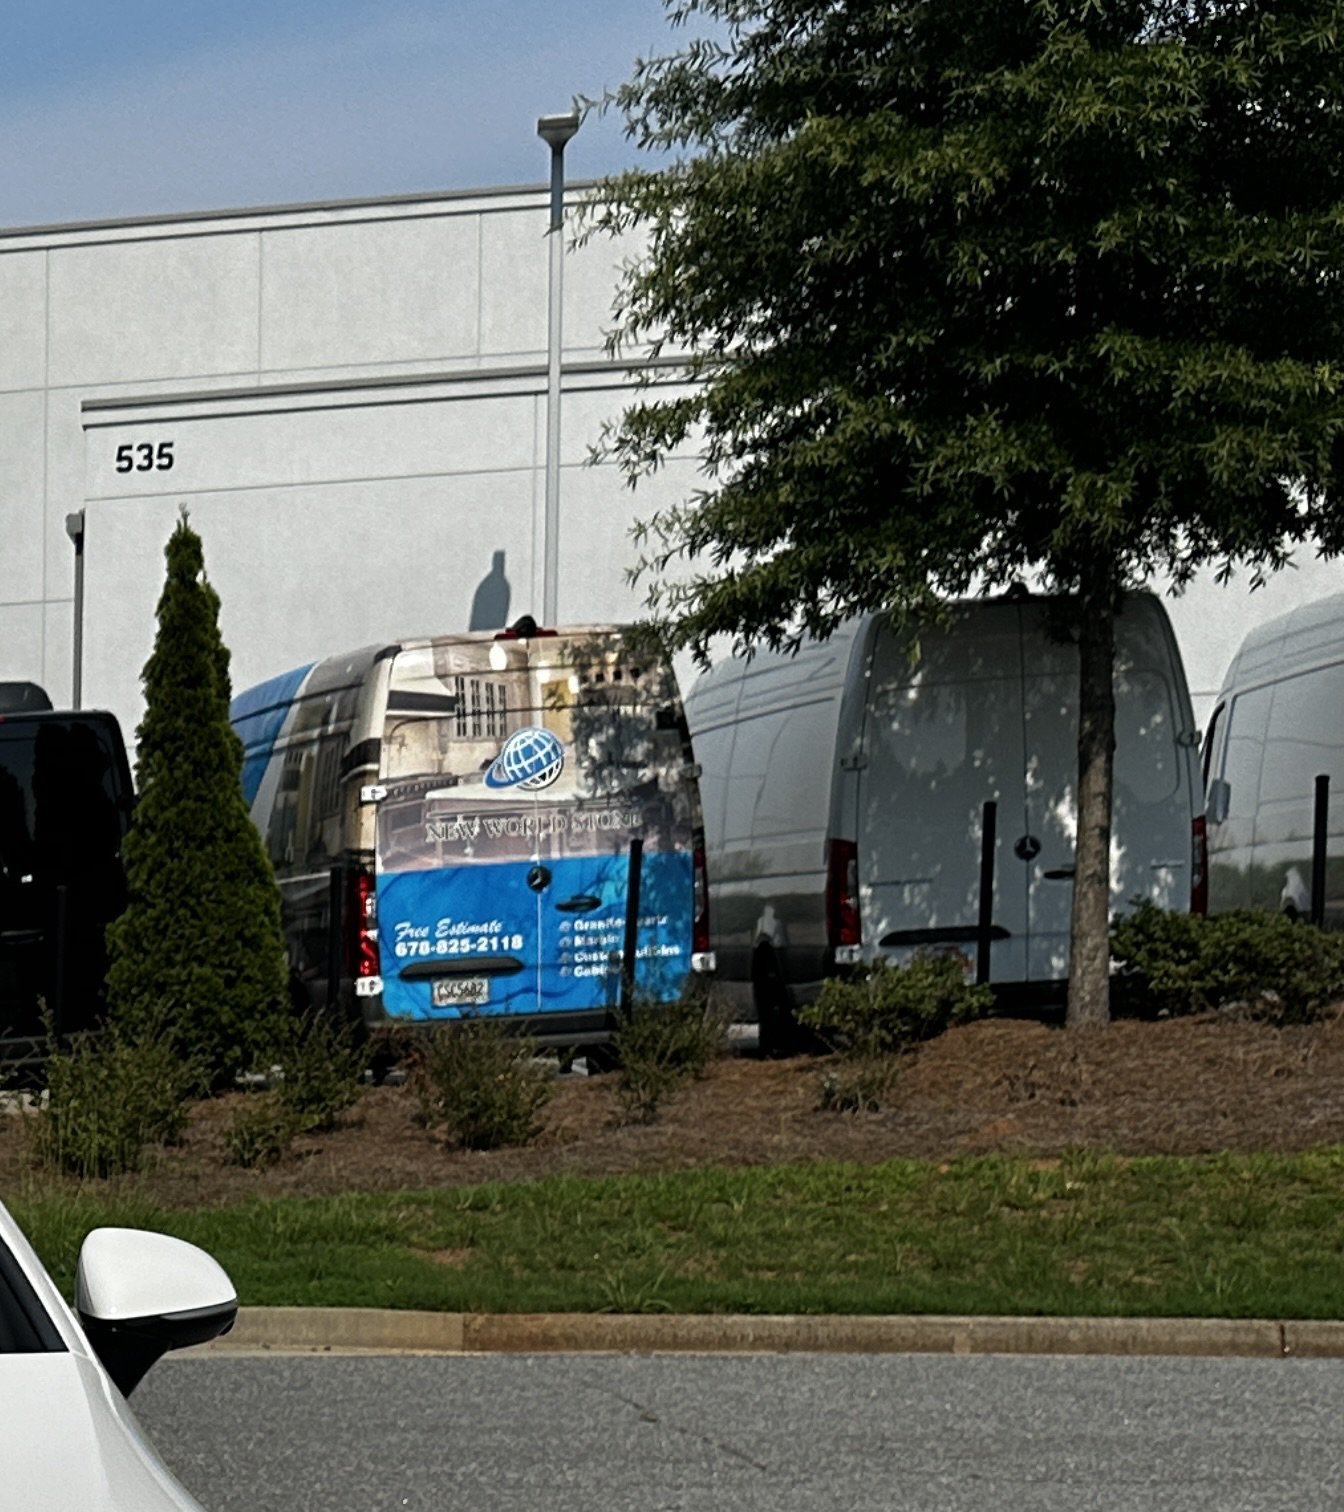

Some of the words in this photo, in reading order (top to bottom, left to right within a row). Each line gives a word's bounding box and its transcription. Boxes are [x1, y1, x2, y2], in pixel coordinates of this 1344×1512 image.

[115, 441, 174, 473] 535
[426, 818, 480, 842] NEW
[483, 813, 568, 837] WORLD
[571, 810, 643, 832] STONE
[395, 922, 430, 942] Free
[435, 917, 503, 938] Estimate
[395, 934, 524, 957] 678-825-2118
